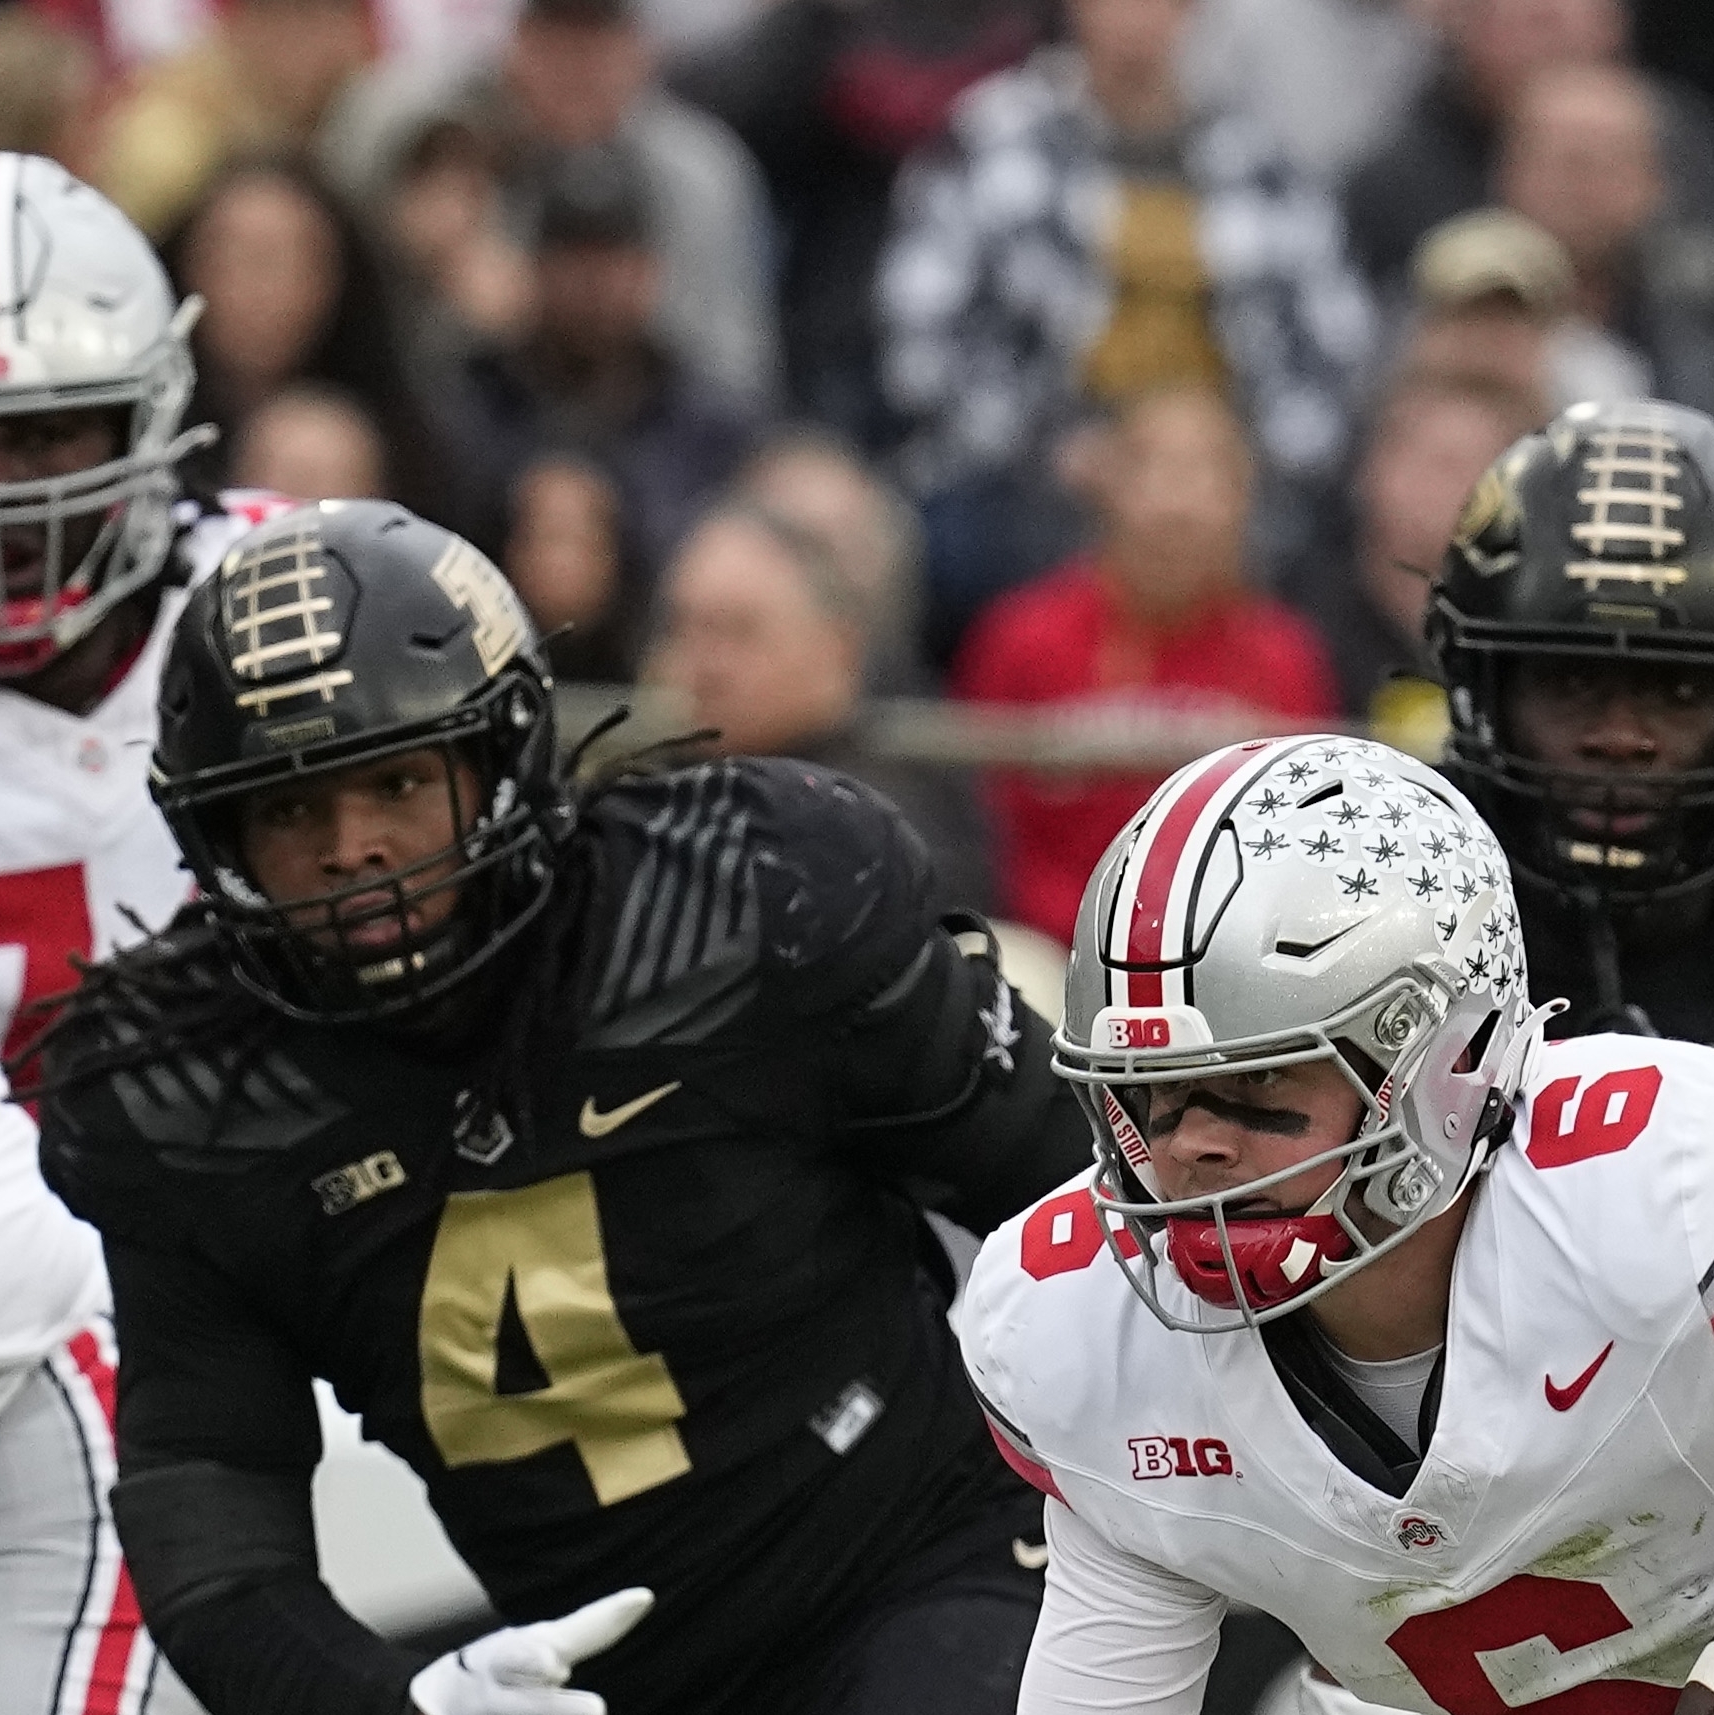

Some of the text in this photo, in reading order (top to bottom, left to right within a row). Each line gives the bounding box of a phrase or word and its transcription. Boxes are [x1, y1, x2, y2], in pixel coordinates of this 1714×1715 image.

[1116, 1123, 1153, 1168] STATE
[1525, 1064, 1663, 1170] 6
[418, 1170, 692, 1507] 4
